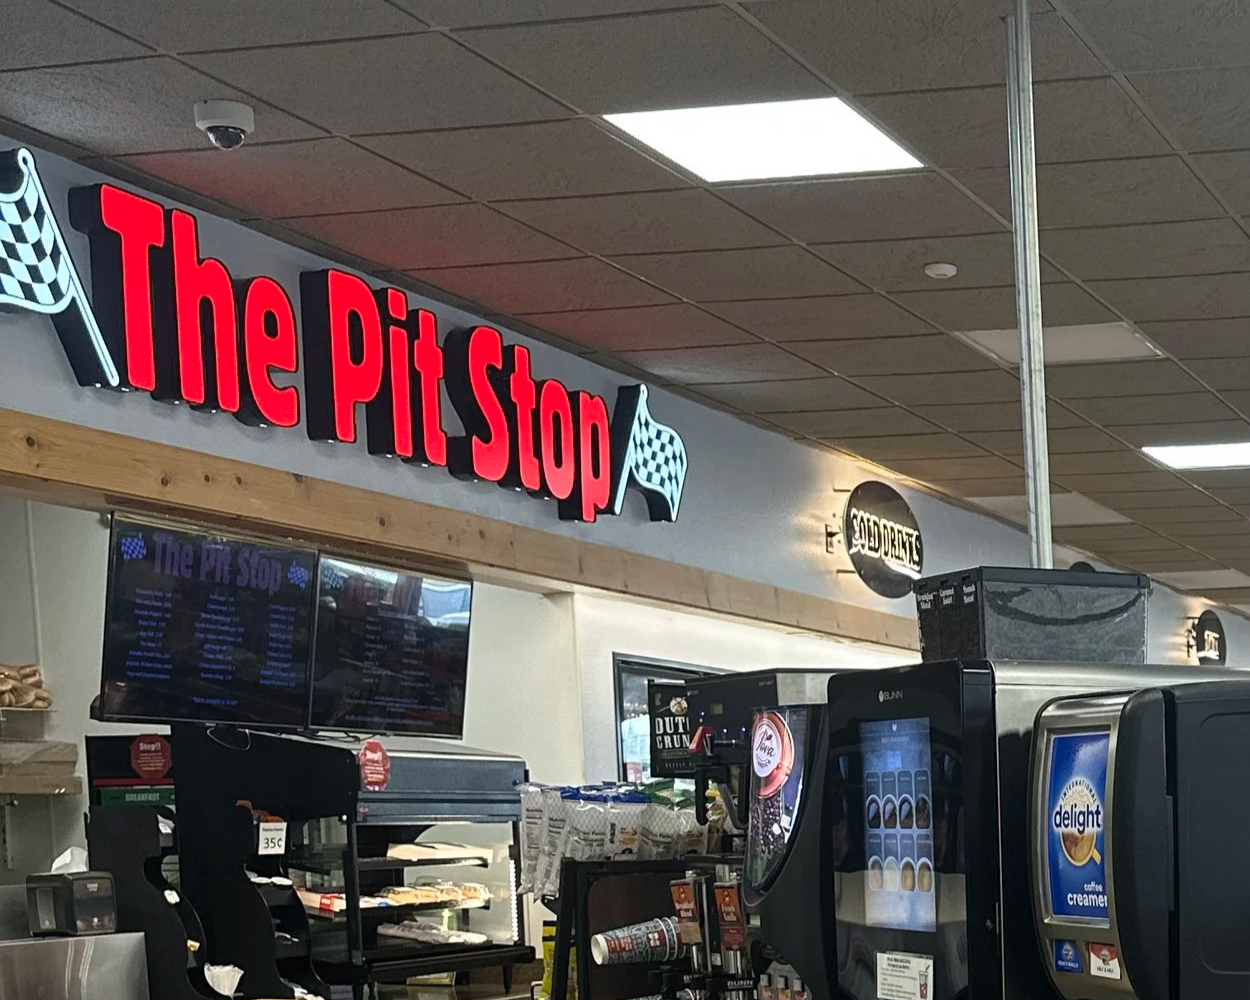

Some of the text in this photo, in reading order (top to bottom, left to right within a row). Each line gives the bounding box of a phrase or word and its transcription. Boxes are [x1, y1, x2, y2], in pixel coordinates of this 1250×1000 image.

[101, 183, 612, 523] The Pit Stop
[851, 508, 921, 571] COLD DRINKS
[152, 531, 282, 597] The Pit Stop
[655, 716, 690, 734] DUT
[1061, 779, 1097, 804] INTERNATIONAL
[1054, 803, 1102, 835] delight
[263, 837, 283, 849] 35¢
[1084, 883, 1103, 892] coffee
[726, 980, 754, 988] BUNN
